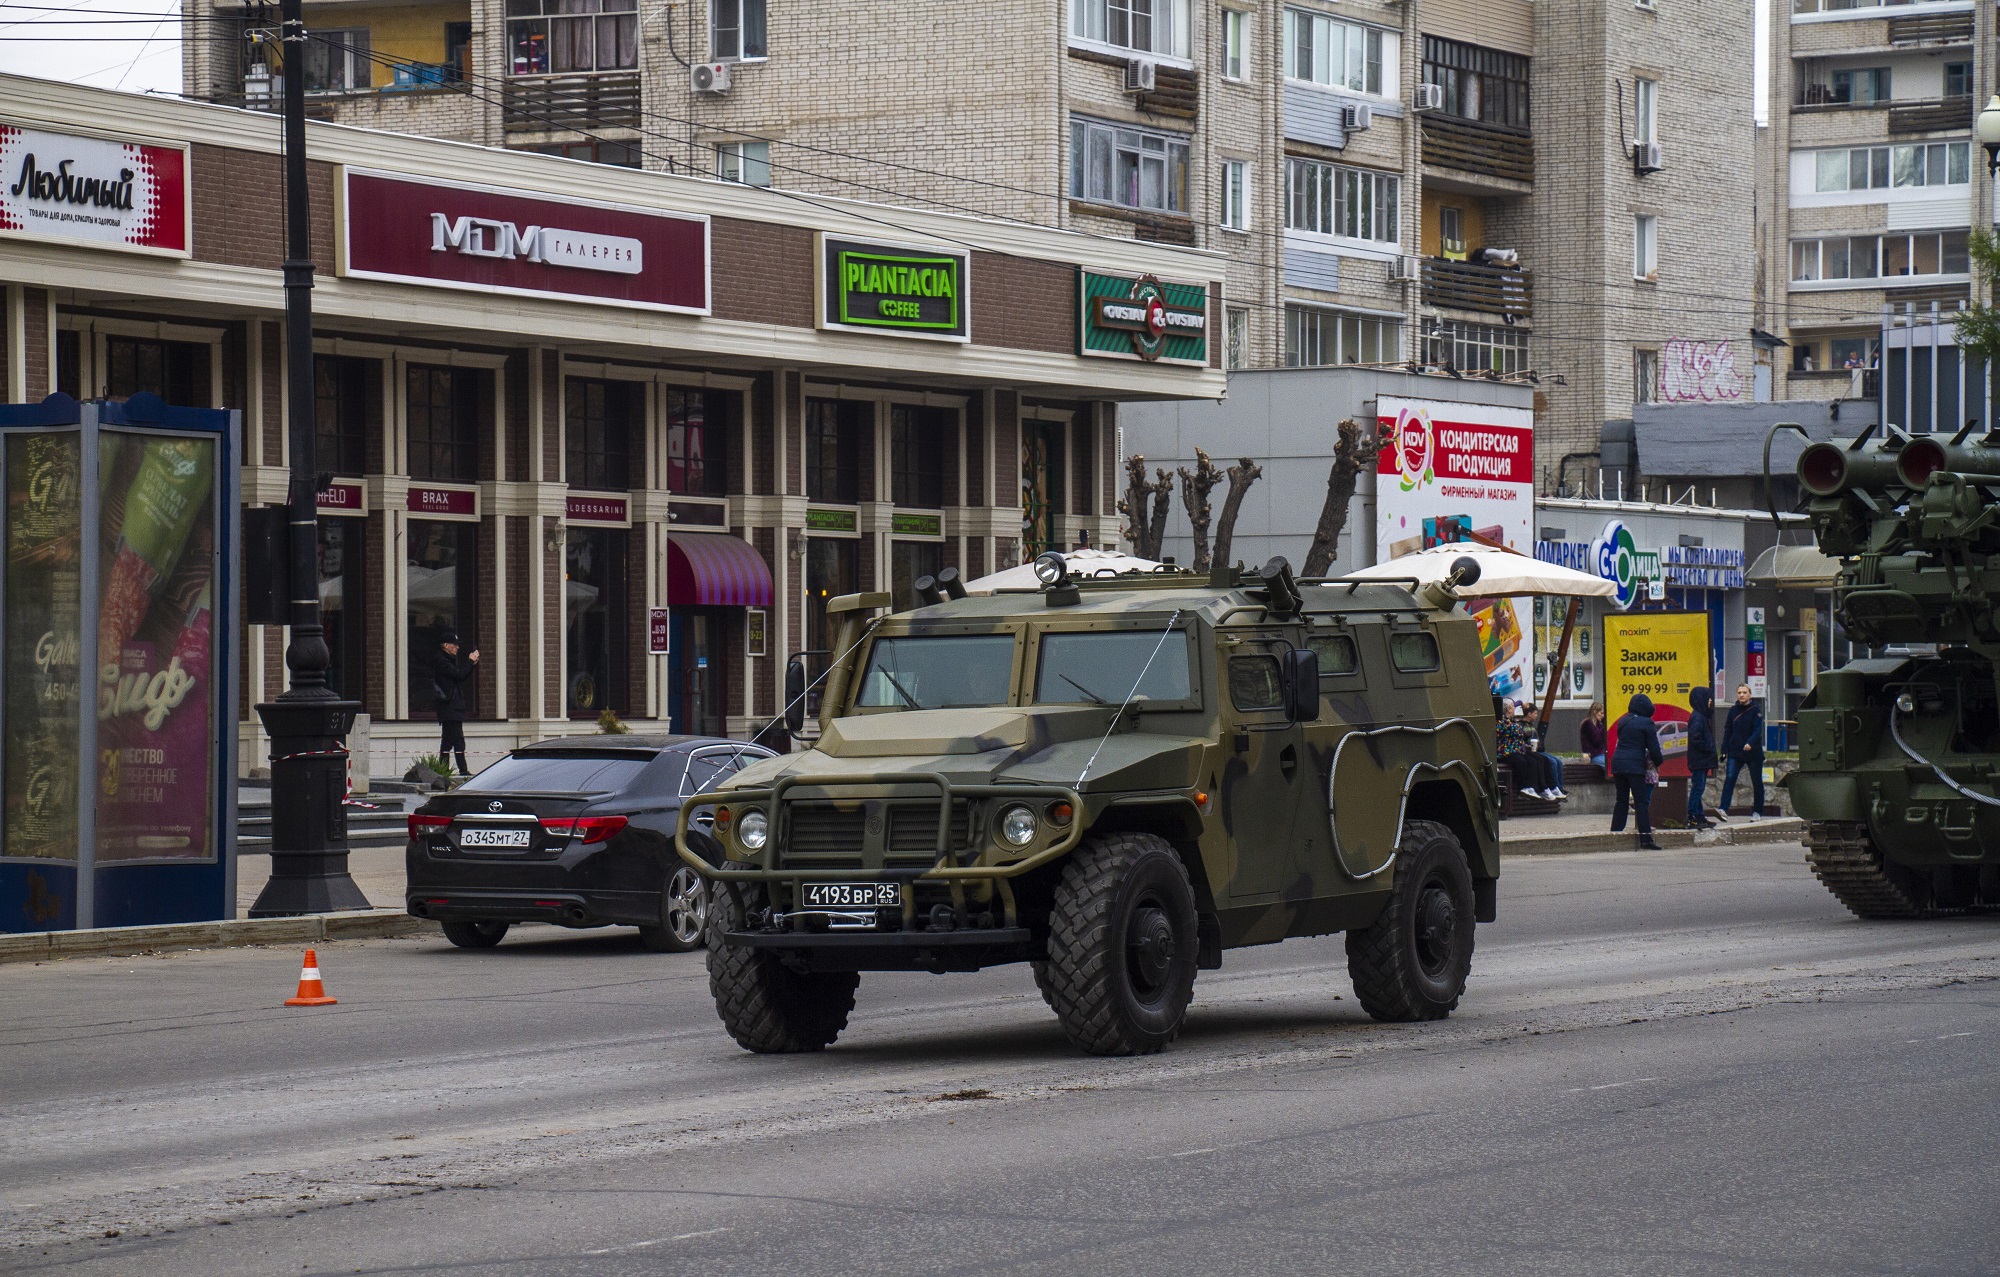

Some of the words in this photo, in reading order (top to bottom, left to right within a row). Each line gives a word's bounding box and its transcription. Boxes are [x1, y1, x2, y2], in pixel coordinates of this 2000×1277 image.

[11, 152, 135, 210] Любимый
[29, 208, 49, 218] ТОВАРЫ
[49, 211, 60, 220] ДЛЯ
[75, 215, 94, 224] КРАСОТЫ
[98, 217, 121, 227] ЗДОРОВЬЯ
[430, 212, 542, 263] MDM
[555, 240, 632, 262] ГАЛЕРЕЯ
[847, 262, 952, 298] PLANTACIA
[878, 299, 920, 319] COFFEE
[1153, 307, 1166, 327] &
[1165, 312, 1205, 329] GUSTAV
[1404, 431, 1425, 447] KDV
[1440, 429, 1519, 454] КОНДИТЕРСКАЯ
[1448, 453, 1511, 478] ПРОДУКЦИЯ
[422, 491, 449, 504] BRAX
[1441, 485, 1485, 499] ФИРМЕННЫЙ
[1487, 487, 1517, 501] МАГАЗИН
[1668, 546, 1681, 563] МЫ
[1684, 547, 1744, 567] КОНТРОЛИРУЕМ
[1668, 568, 1708, 586] КАЧЕСТВО
[1714, 569, 1719, 586] И
[1724, 569, 1744, 587] ЦЕНЫ
[1620, 628, 1650, 636] maxim
[1620, 649, 1677, 662] Закажи
[1621, 665, 1662, 676] такси
[514, 831, 526, 842] 27
[877, 884, 895, 899] 25
